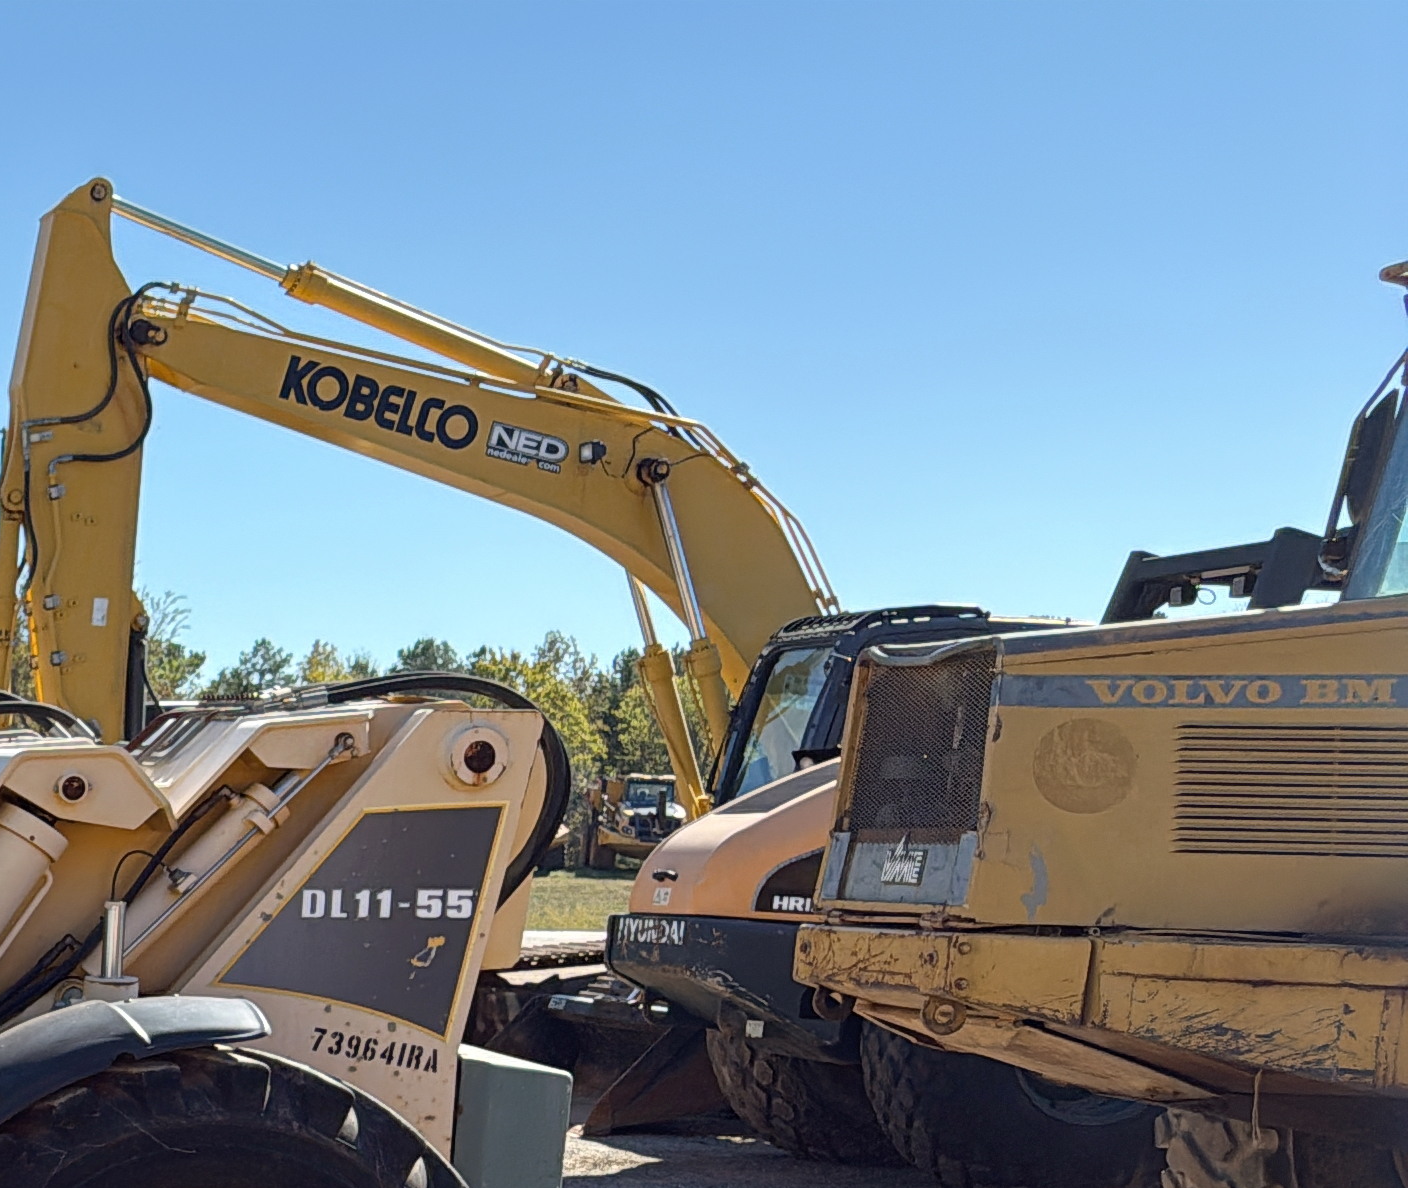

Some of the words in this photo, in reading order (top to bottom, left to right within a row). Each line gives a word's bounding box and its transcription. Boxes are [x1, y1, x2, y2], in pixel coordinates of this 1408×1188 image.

[279, 355, 478, 449] KOBELCO
[489, 425, 566, 460] NED
[1086, 679, 1282, 704] VOLVO
[1299, 678, 1398, 704] BM
[301, 888, 474, 919] DL11-55
[772, 895, 813, 913] HRI
[616, 917, 686, 945] HYUNDAI
